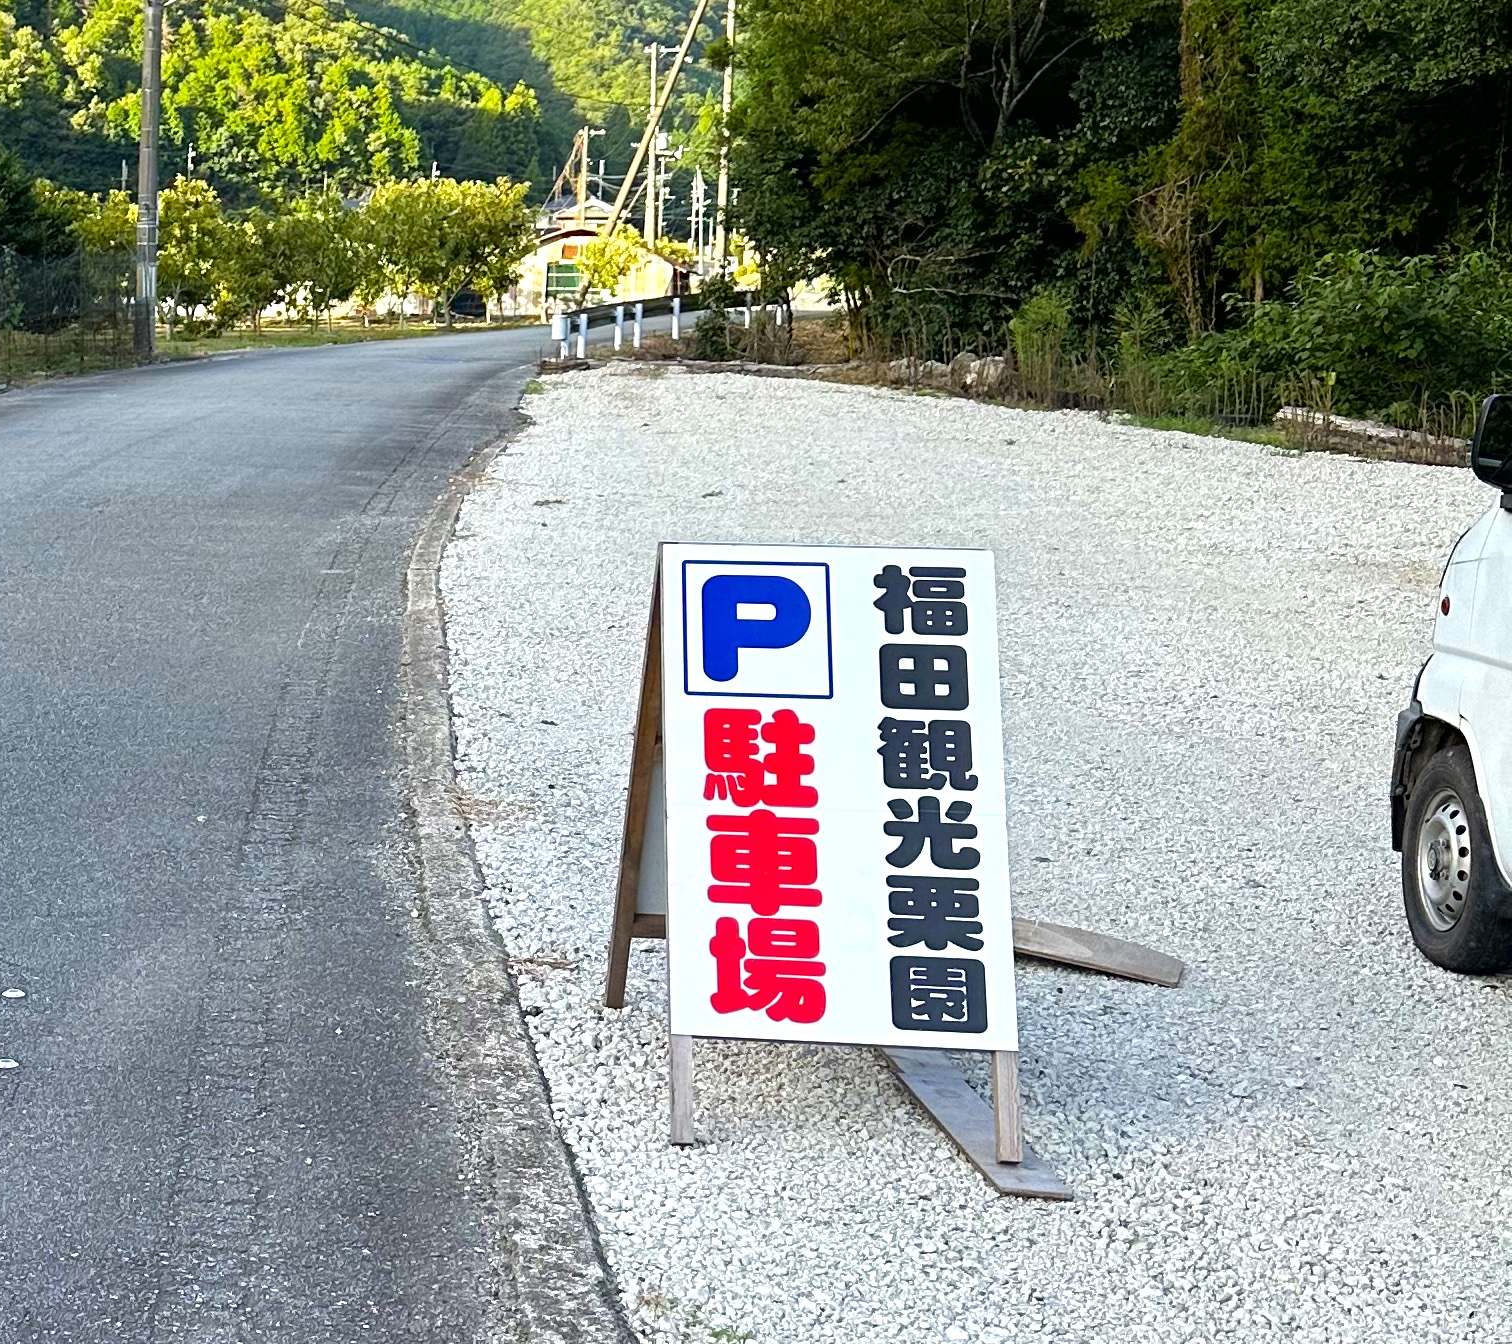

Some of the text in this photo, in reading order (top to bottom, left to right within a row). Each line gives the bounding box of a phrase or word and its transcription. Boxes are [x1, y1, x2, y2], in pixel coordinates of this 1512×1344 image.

[702, 575, 811, 682] P
[703, 708, 826, 1023] 駐車場
[873, 565, 988, 1033] 福田観光栗園
